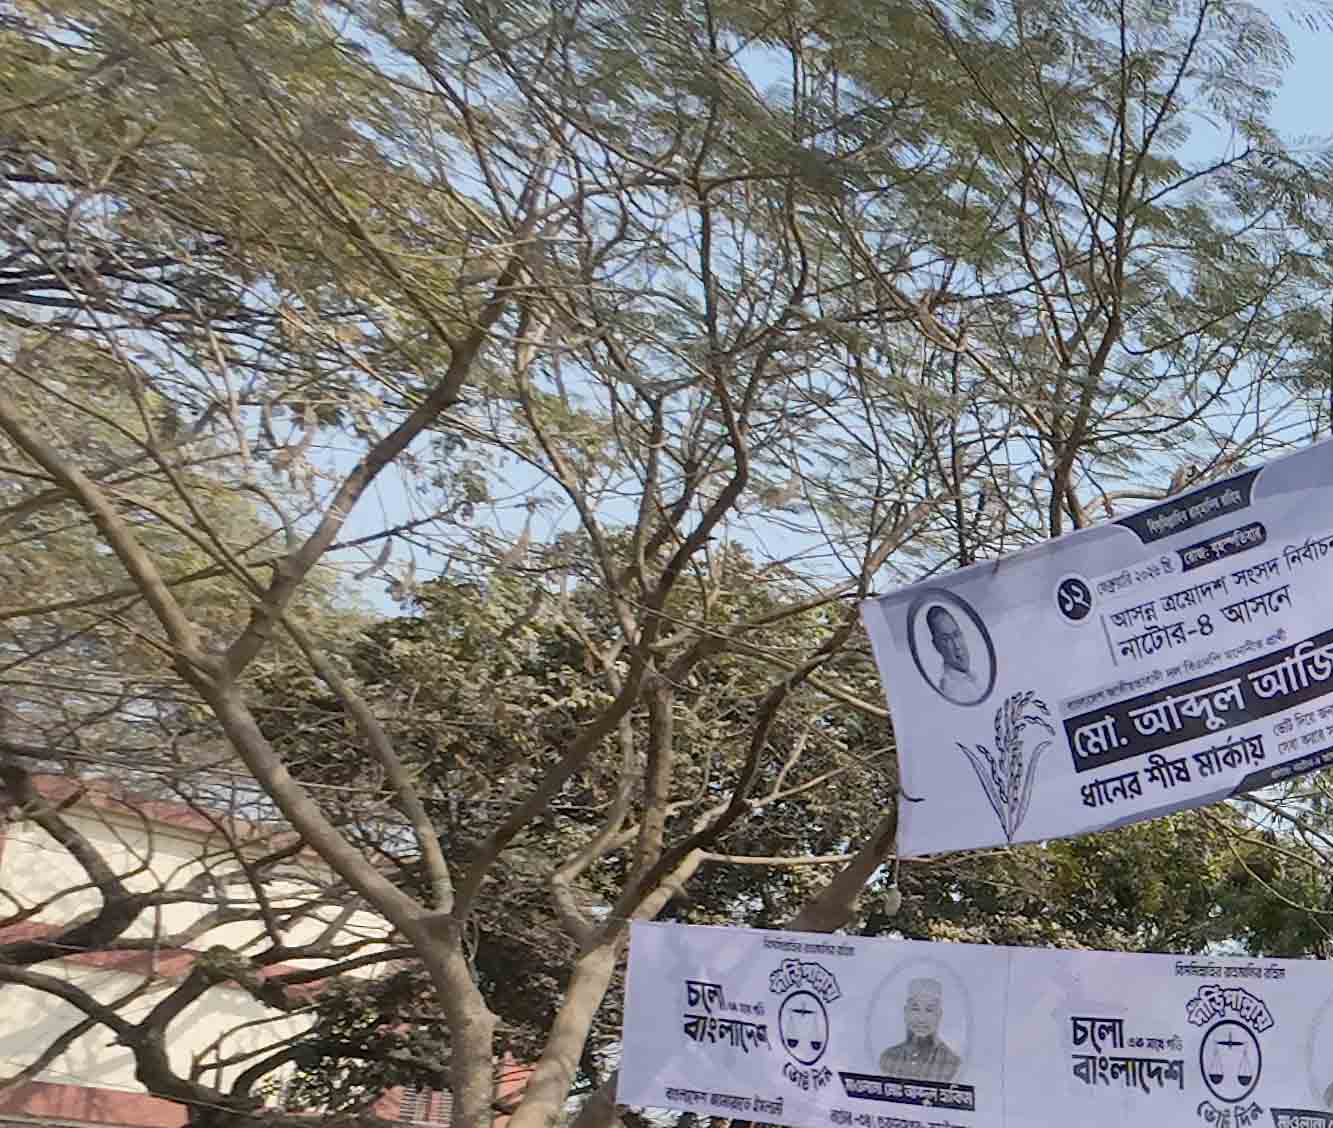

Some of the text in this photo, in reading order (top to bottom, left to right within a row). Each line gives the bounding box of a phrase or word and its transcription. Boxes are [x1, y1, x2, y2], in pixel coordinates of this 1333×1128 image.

[1110, 601, 1158, 627] আসন্ন
[1160, 576, 1229, 612] ত্রয়োদশ
[1230, 558, 1280, 586] সংসদ
[1118, 584, 1292, 661] নাটোর-৪ আসনে
[1073, 714, 1128, 759] মো.
[1128, 677, 1246, 729] আব্দুল
[1080, 771, 1144, 809] ধানের
[1144, 753, 1192, 790] শীষ
[1192, 733, 1266, 778] মার্কায়
[1071, 1016, 1124, 1054] চলো
[1072, 1054, 1184, 1094] বাংলাদেশ
